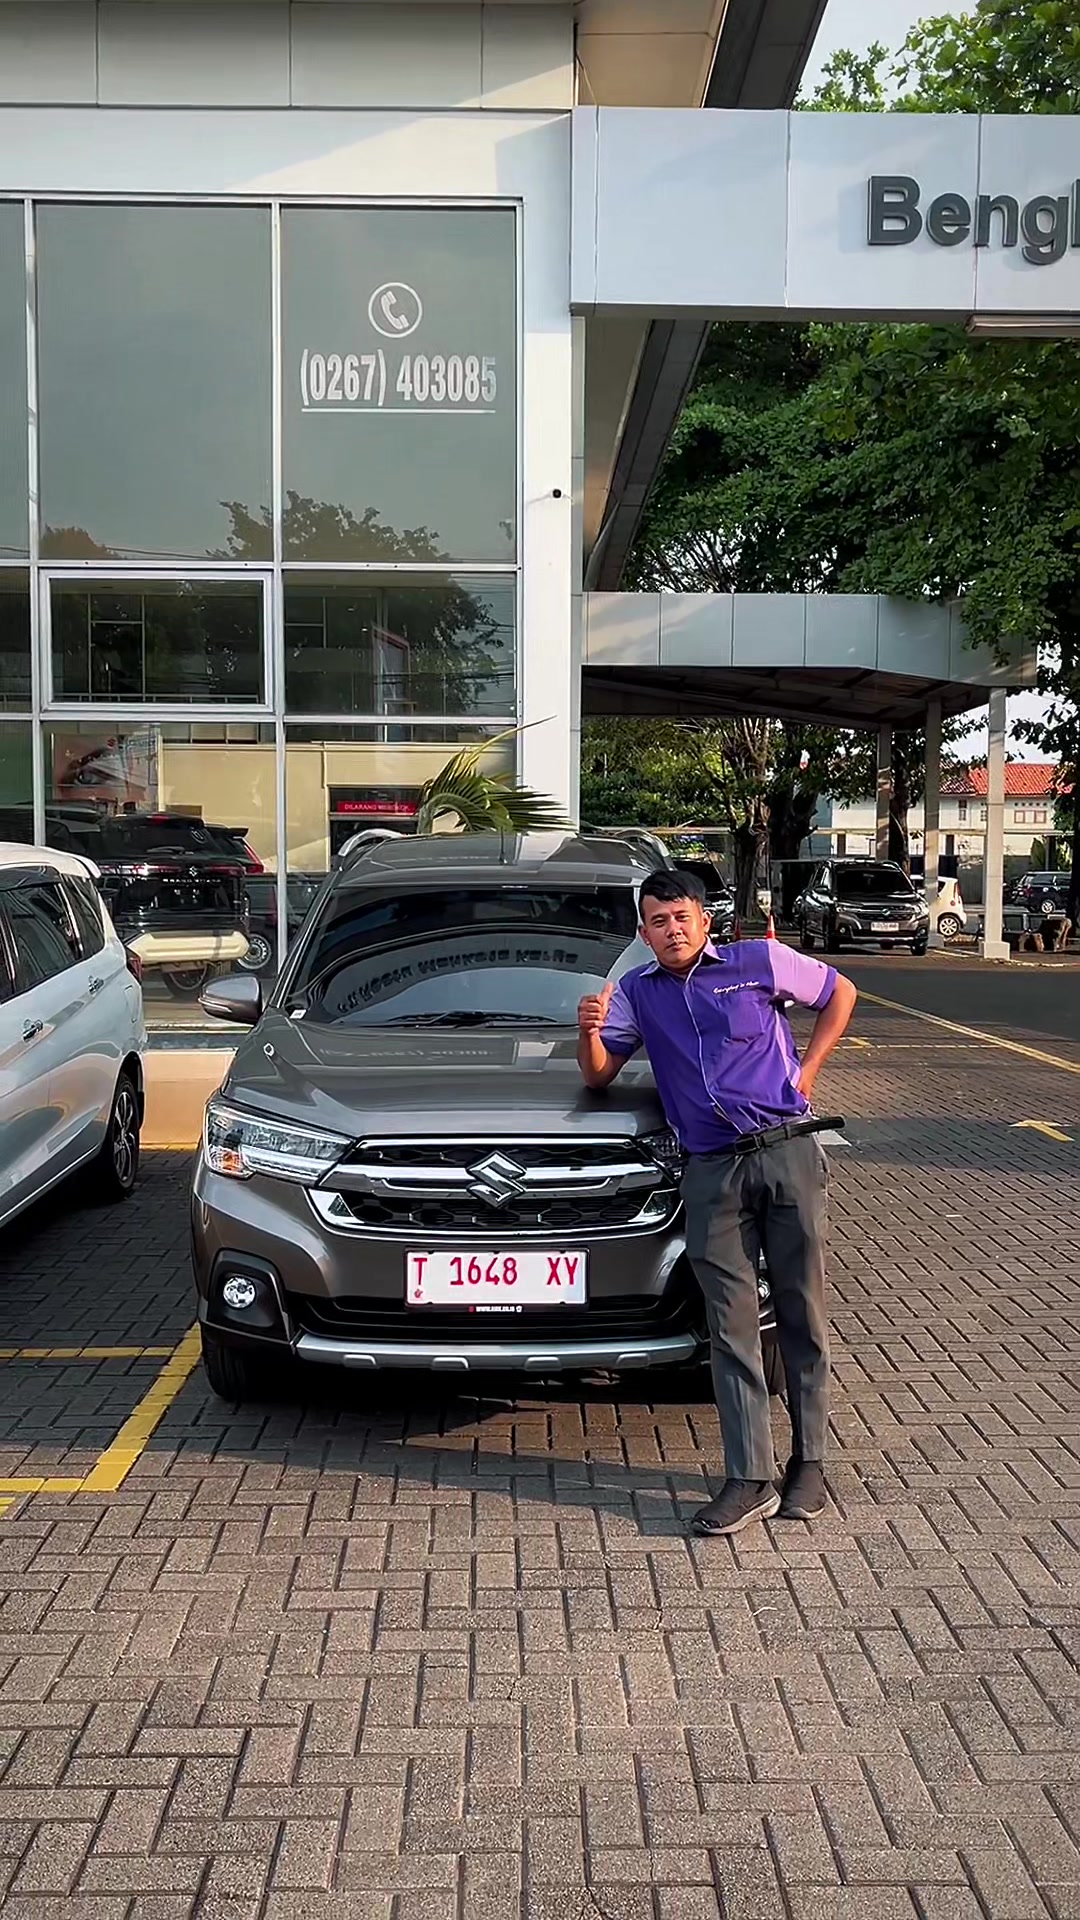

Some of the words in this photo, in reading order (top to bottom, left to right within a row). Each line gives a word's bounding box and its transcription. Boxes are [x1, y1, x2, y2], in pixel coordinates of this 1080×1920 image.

[867, 175, 1080, 266] Beng
[300, 348, 387, 406] (0267)
[396, 354, 497, 402] 403085
[413, 1257, 428, 1285] T
[450, 1256, 518, 1285] 1648
[546, 1256, 579, 1285] XY
